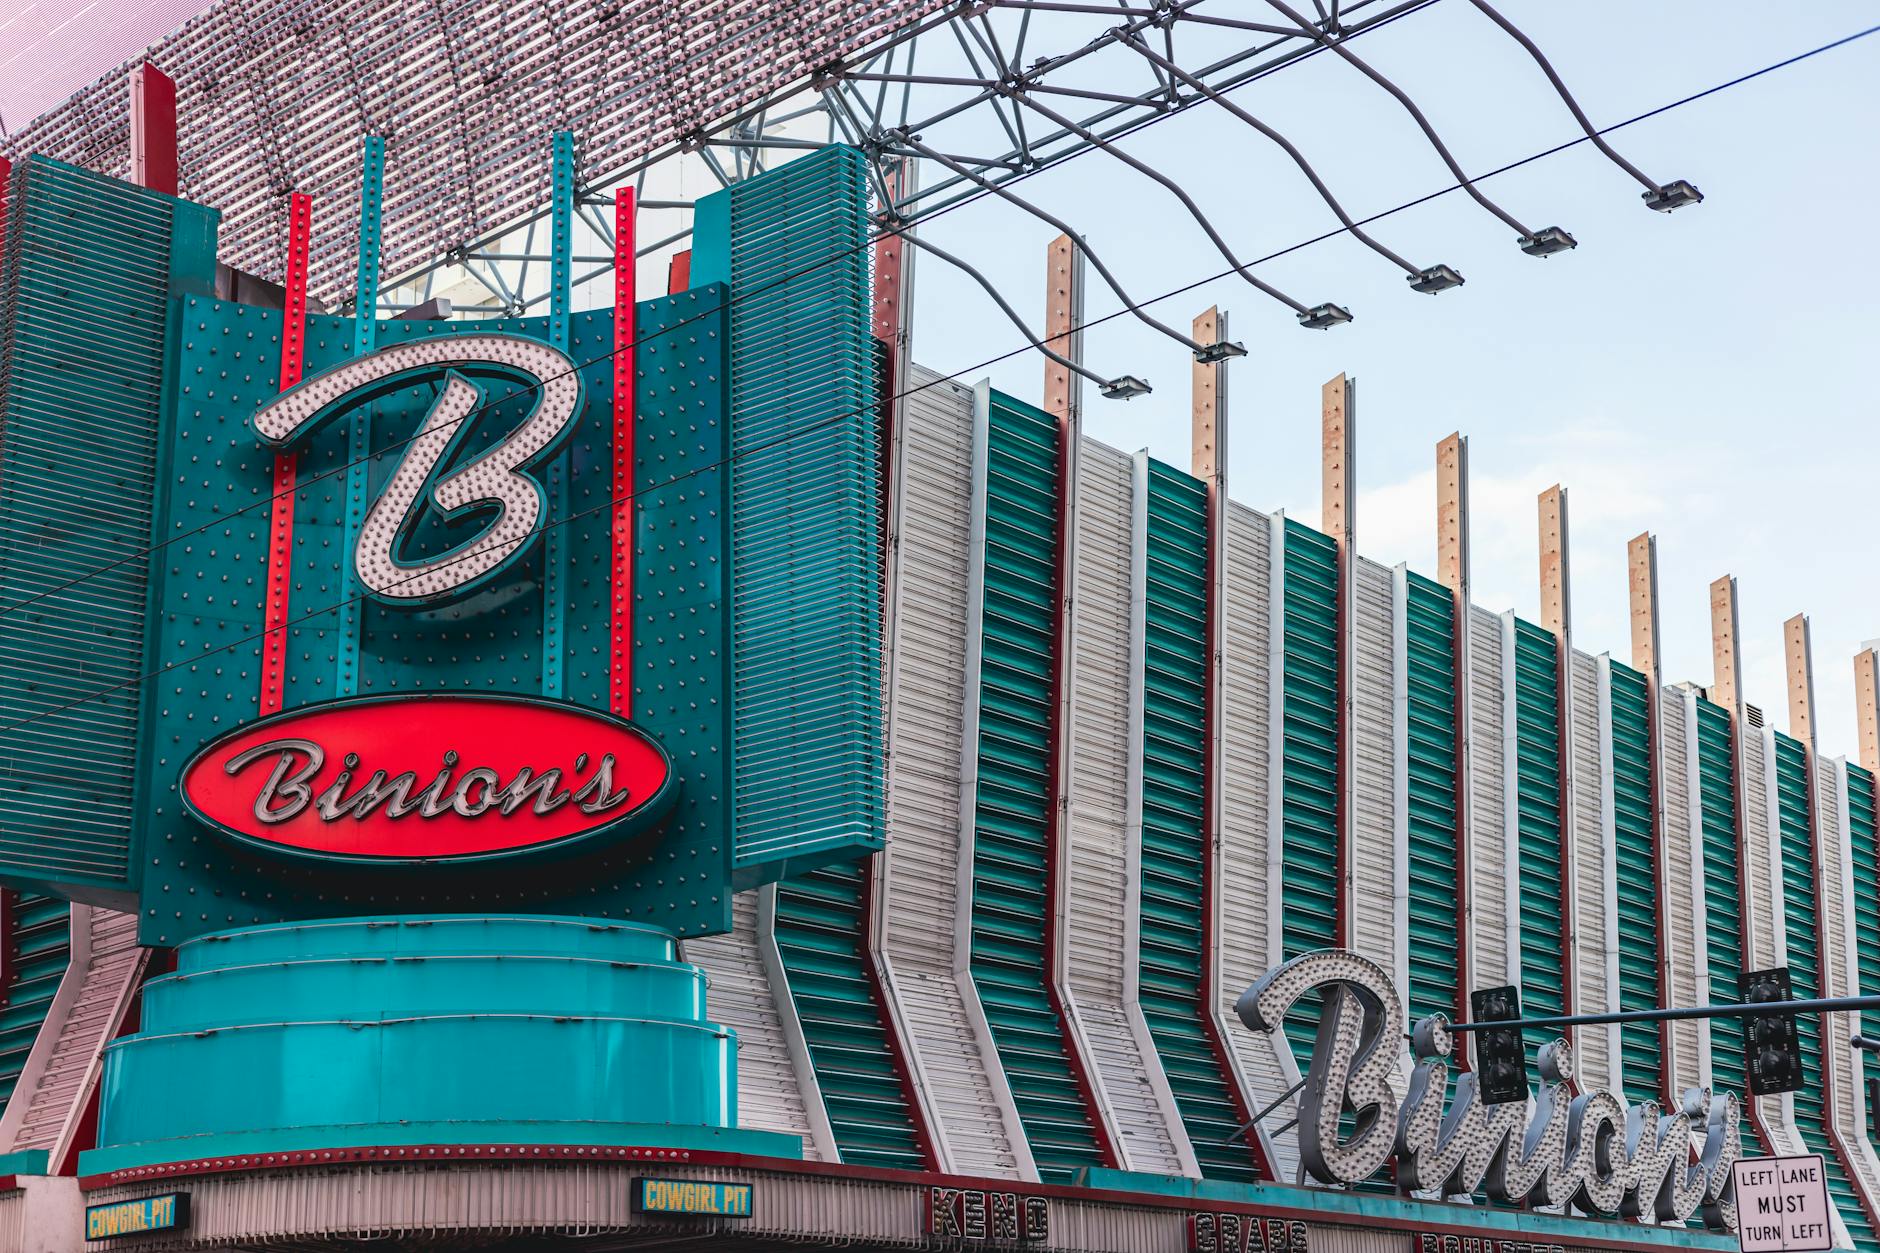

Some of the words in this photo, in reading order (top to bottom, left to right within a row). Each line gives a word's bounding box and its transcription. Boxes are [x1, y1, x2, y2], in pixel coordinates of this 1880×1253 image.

[251, 332, 587, 604] B
[224, 738, 629, 824] Binion's
[1741, 1170, 1773, 1187] LEFT
[1781, 1167, 1818, 1184] LANE
[89, 1201, 148, 1239] COWGIRL
[151, 1197, 173, 1229] PIT
[645, 1181, 719, 1213] COWGIRL
[723, 1185, 748, 1215] PIT
[931, 1186, 1049, 1241] KENO
[1757, 1194, 1806, 1214] MUST
[1194, 1212, 1308, 1253] CRAPS
[1745, 1226, 1781, 1242] TURN
[1791, 1223, 1824, 1240] LEFT
